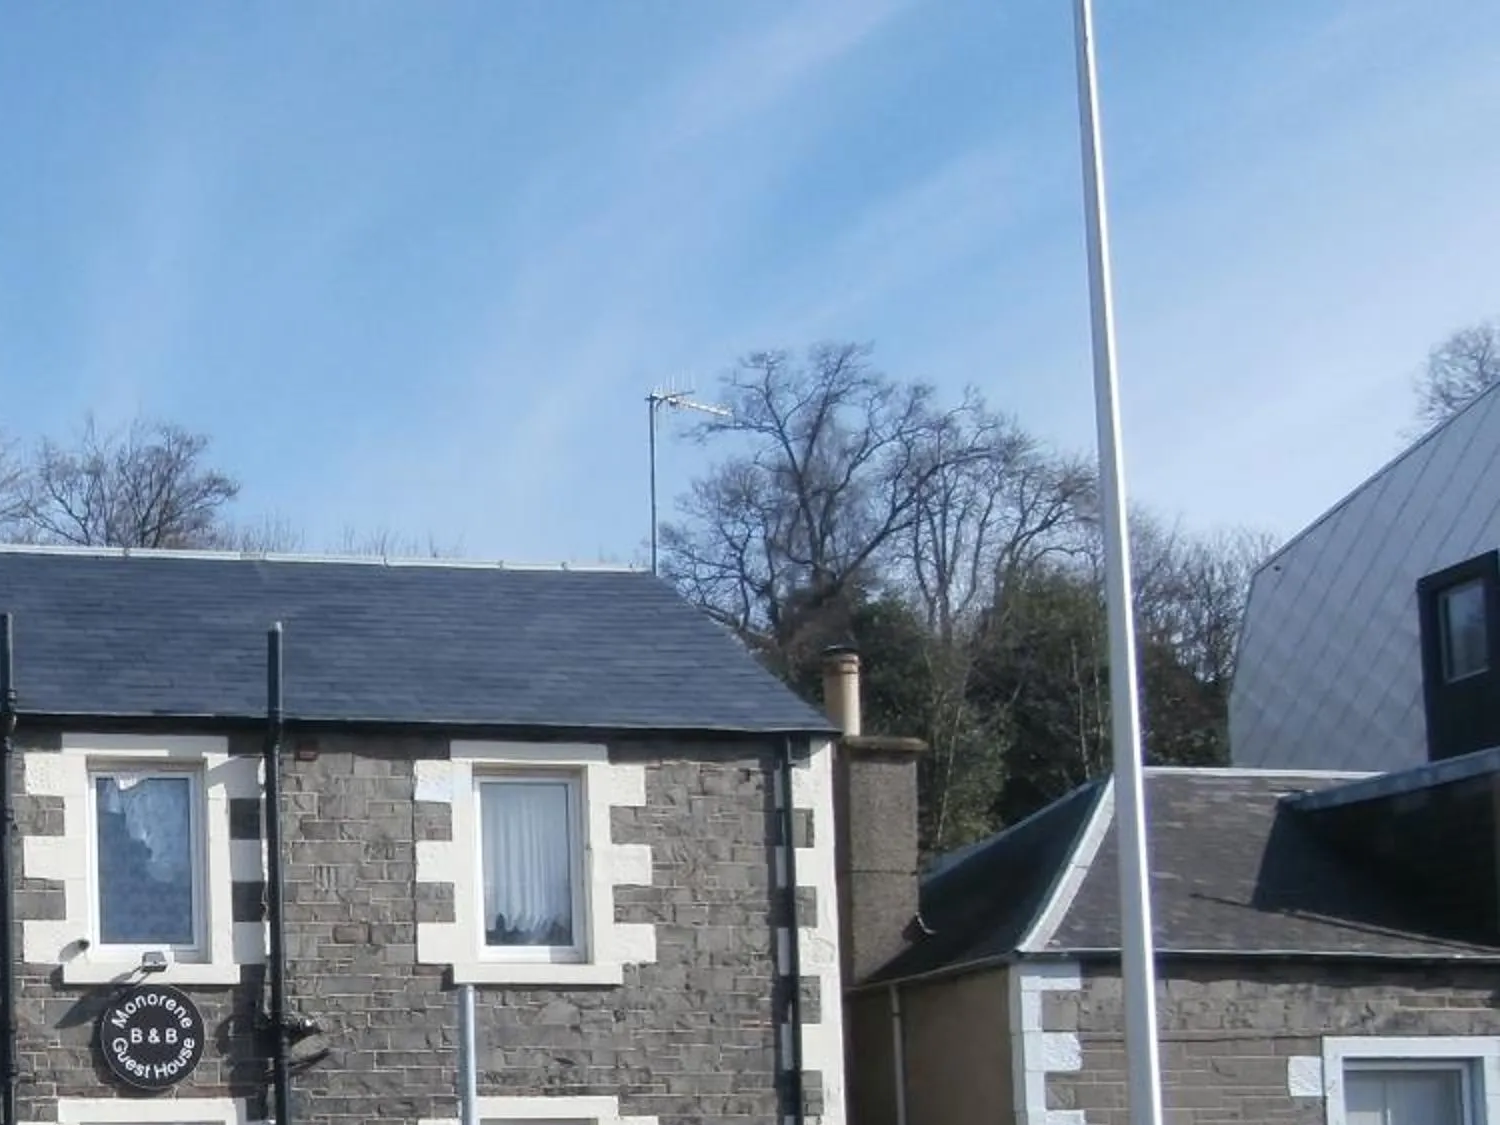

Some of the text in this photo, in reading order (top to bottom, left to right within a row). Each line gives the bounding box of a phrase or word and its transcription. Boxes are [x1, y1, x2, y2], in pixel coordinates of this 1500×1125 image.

[111, 993, 193, 1029] Monorene
[131, 1027, 178, 1043] B & B
[112, 1037, 195, 1079] Guest House
